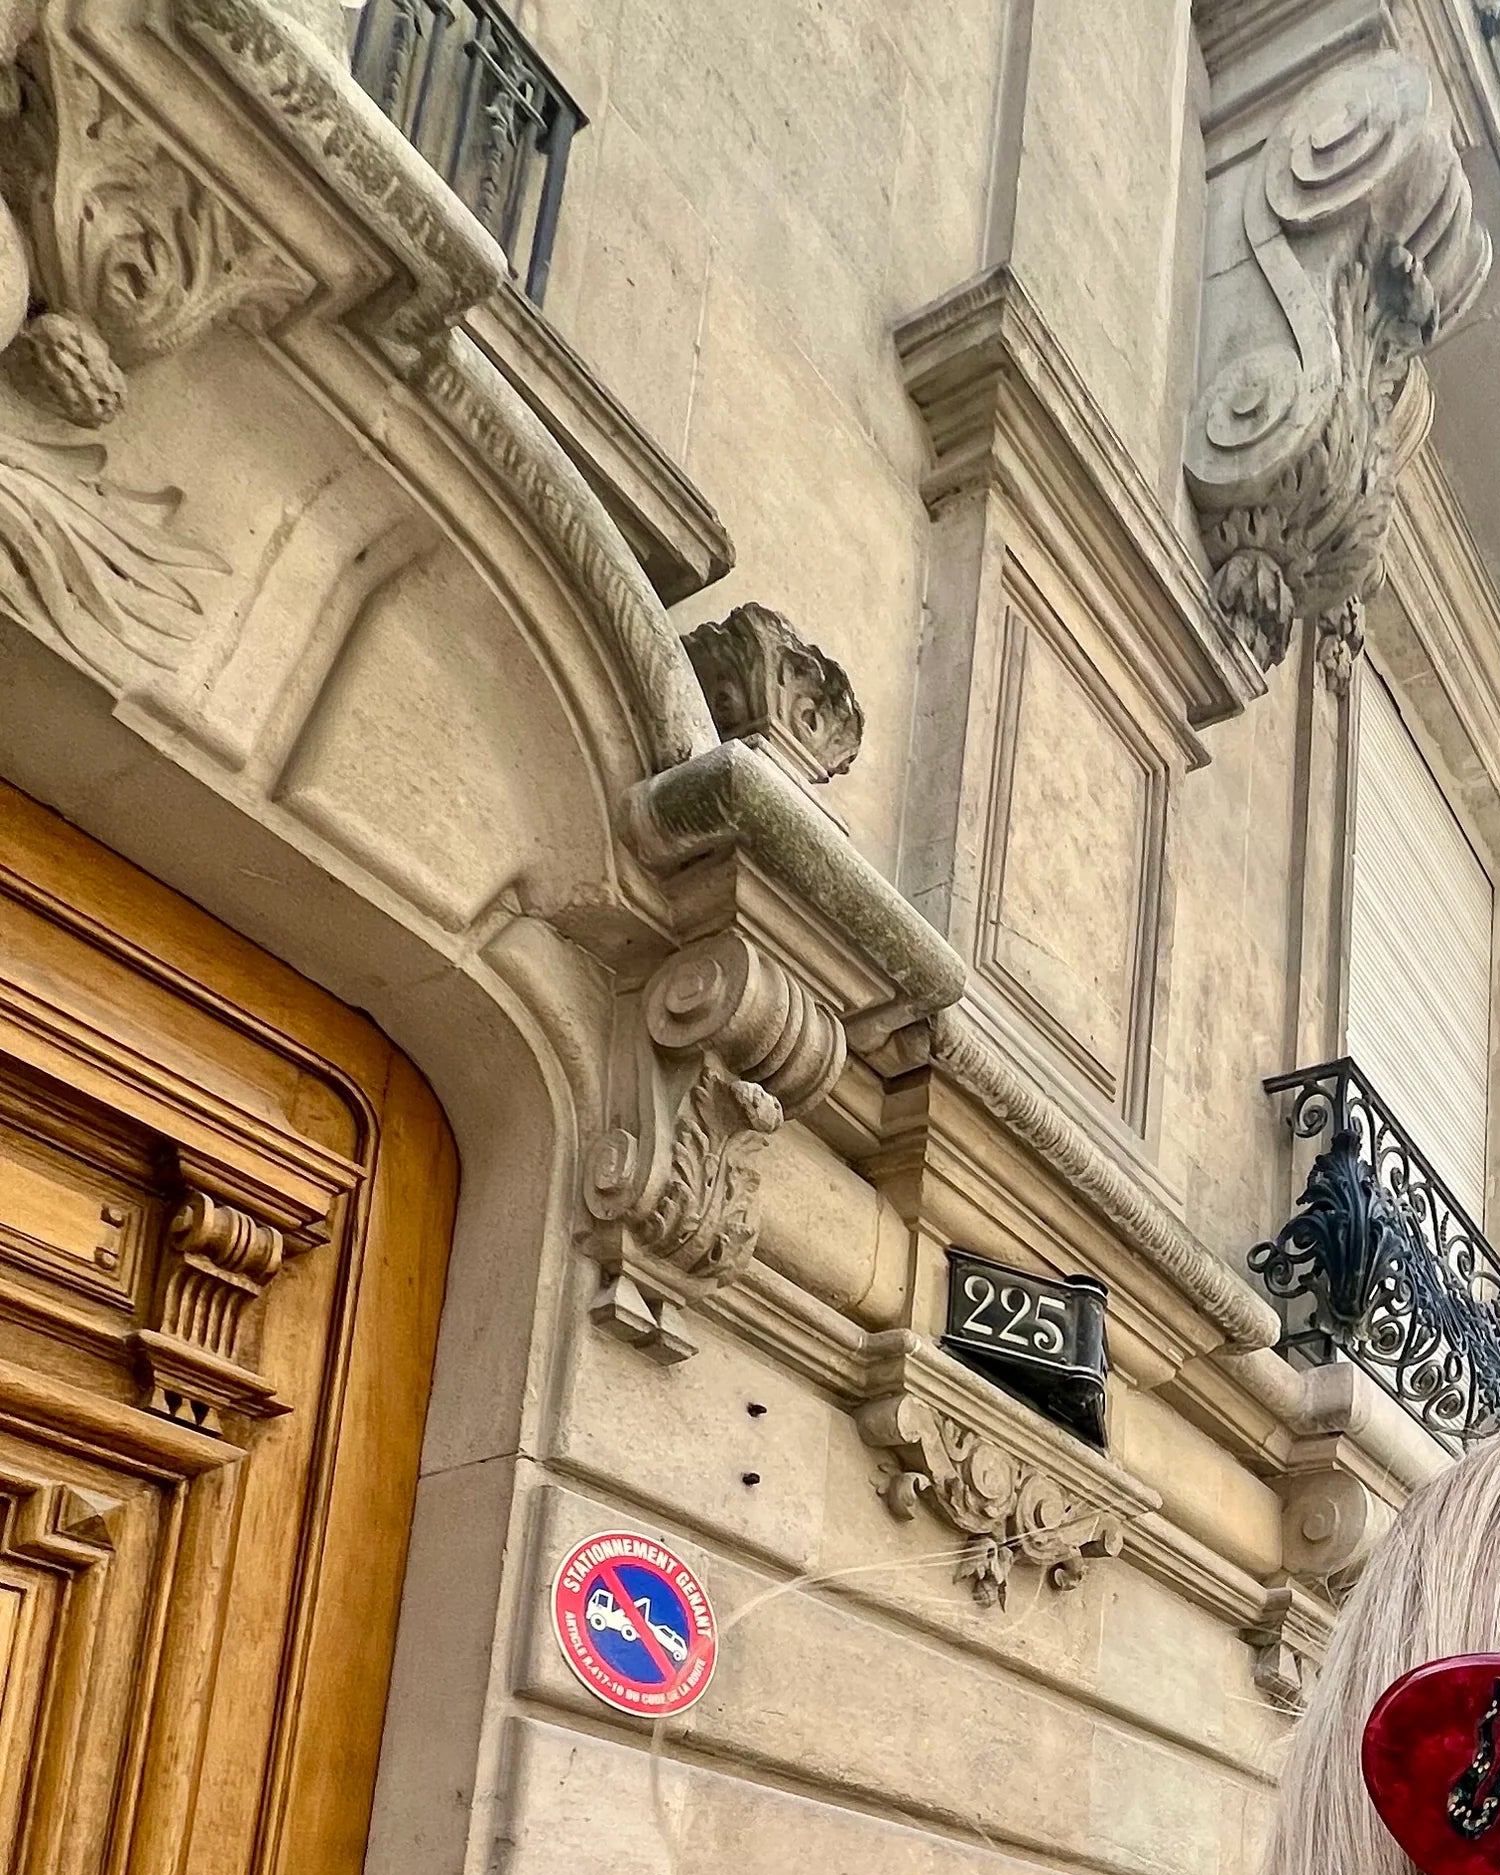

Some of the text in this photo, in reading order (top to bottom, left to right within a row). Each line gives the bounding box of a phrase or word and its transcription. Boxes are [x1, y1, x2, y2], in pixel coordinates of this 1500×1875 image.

[963, 1275, 1066, 1354] 225
[563, 1538, 713, 1638] STATIONNEMENT GENANT
[565, 1610, 588, 1657] ARTICLE
[625, 1689, 640, 1704] DU
[641, 1692, 666, 1706] CODE
[677, 1682, 691, 1696] LA
[687, 1657, 707, 1687] ROUTE
